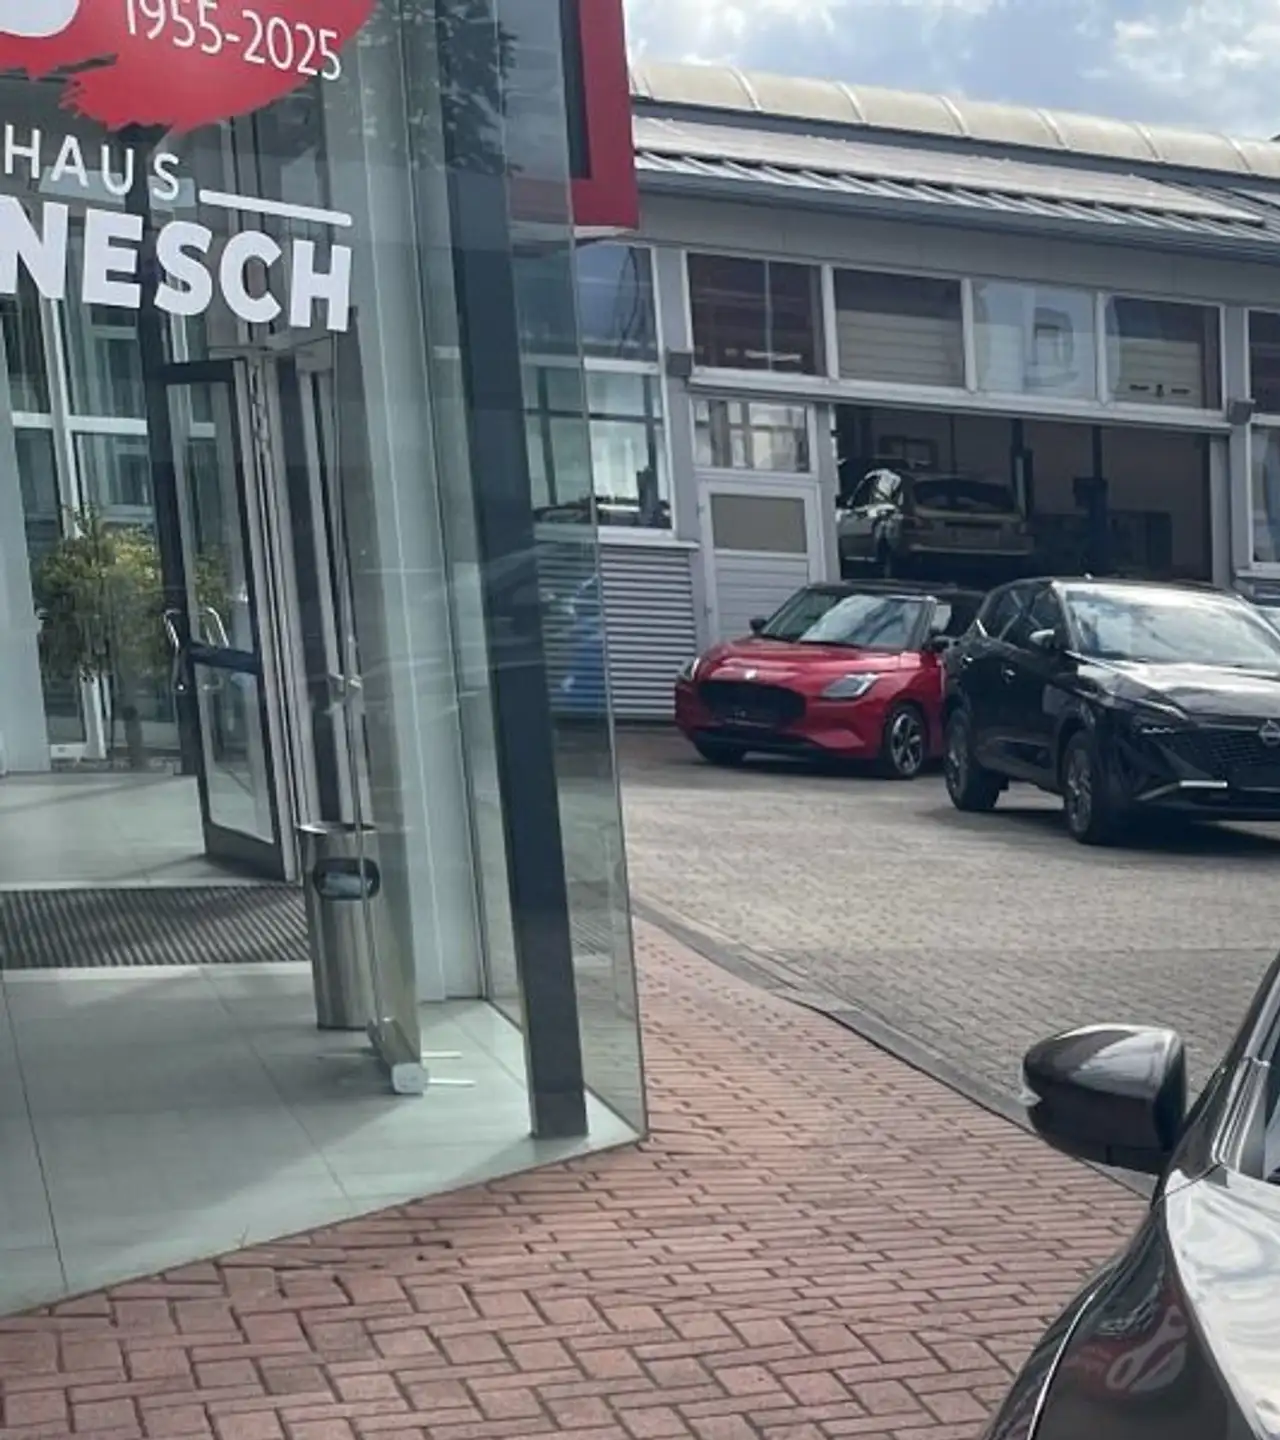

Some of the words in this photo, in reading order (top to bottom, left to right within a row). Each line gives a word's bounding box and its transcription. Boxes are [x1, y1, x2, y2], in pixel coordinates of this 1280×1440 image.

[125, 0, 342, 80] 1955-2025
[4, 124, 180, 201] HAUS
[0, 194, 352, 332] NESCH
